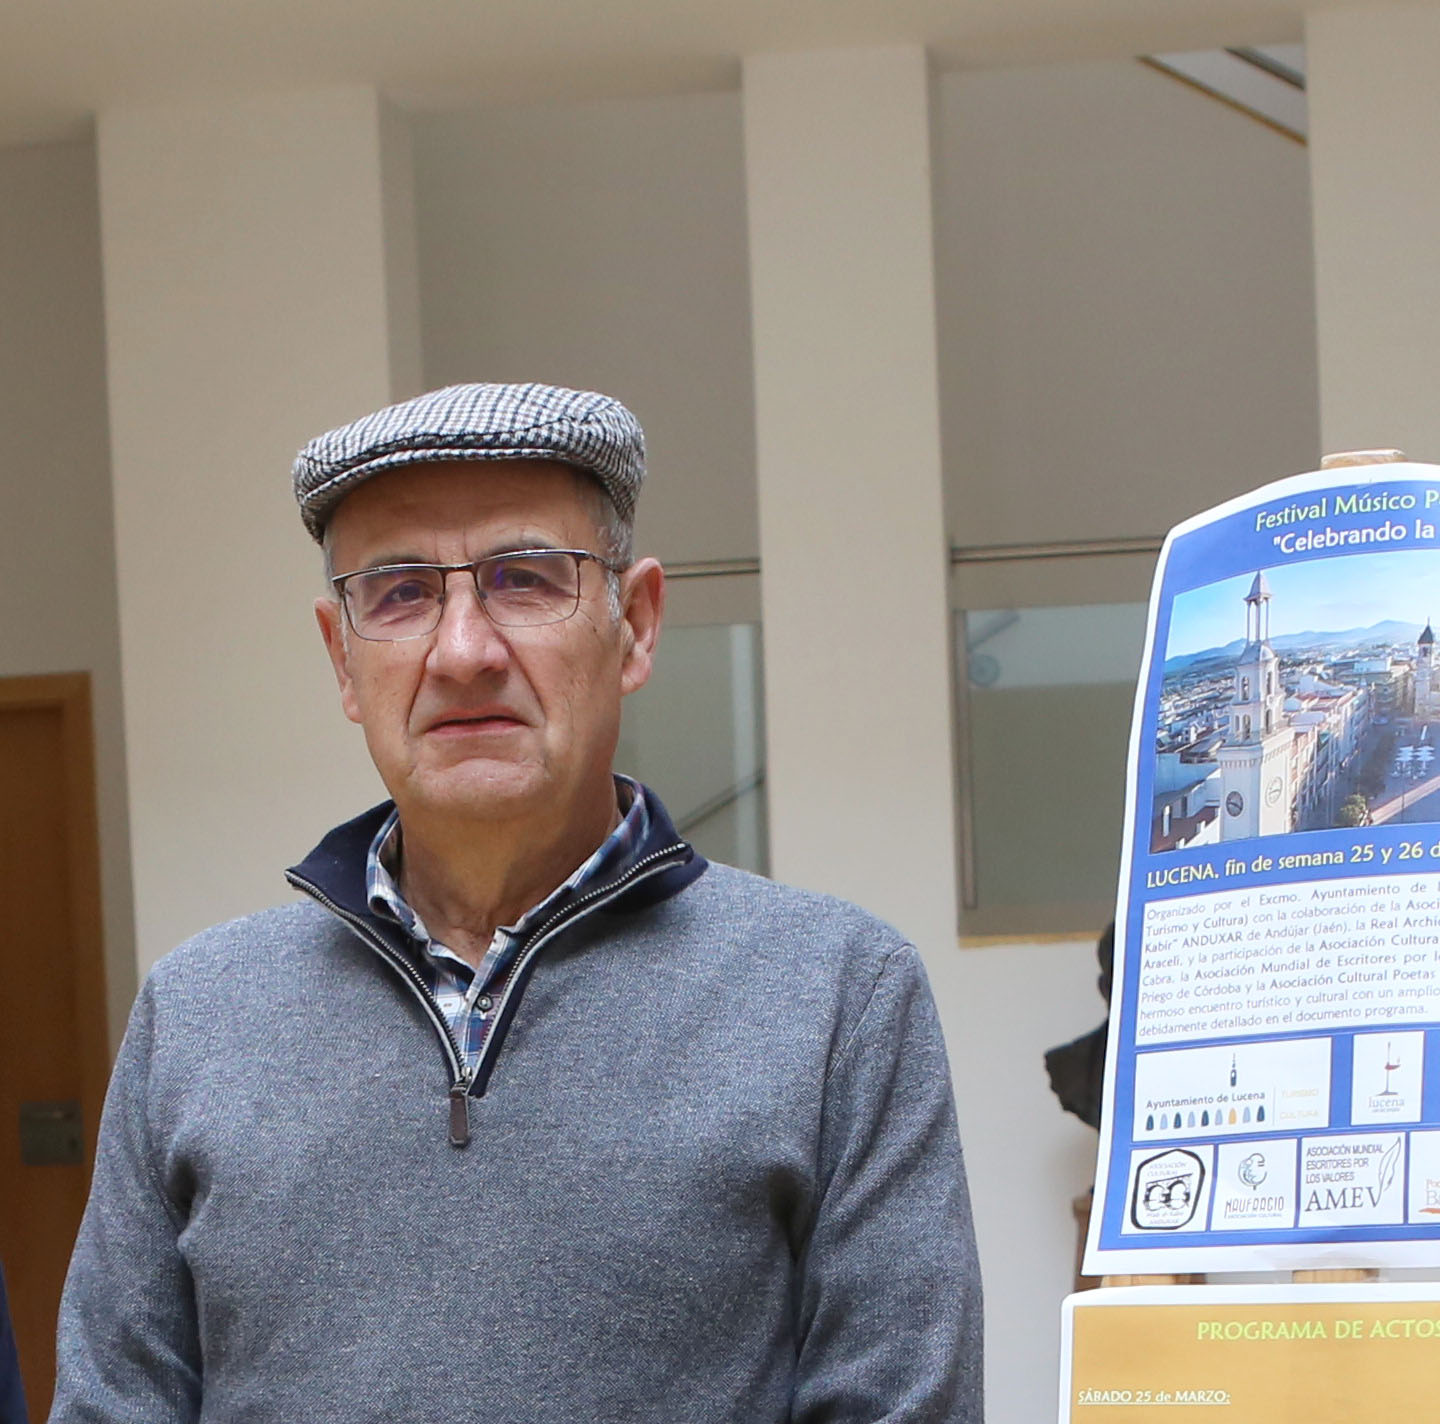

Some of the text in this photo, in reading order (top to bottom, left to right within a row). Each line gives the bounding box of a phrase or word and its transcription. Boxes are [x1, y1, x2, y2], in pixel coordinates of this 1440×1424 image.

[1255, 498, 1327, 532] Festival
[1334, 491, 1415, 517] Músico
[1273, 521, 1406, 554] "Celebrando
[1415, 520, 1434, 539] la
[1225, 859, 1246, 876] fin
[1251, 856, 1272, 872] de
[1278, 850, 1344, 870] semana
[1350, 844, 1374, 863] 25
[1381, 847, 1392, 864] y
[1398, 841, 1424, 860] 26
[1146, 1092, 1265, 1109] Ayuntamiento de Lucena
[1368, 1096, 1405, 1109] lucena
[1306, 1158, 1369, 1170] ESCRITORES POR
[1306, 1174, 1319, 1184] LOS
[1305, 1186, 1380, 1213] AMEV
[1197, 1320, 1327, 1340] PROGRAMA
[1335, 1320, 1364, 1339] DE
[1078, 1387, 1231, 1404] SÁBADO 25 de MARZO:
